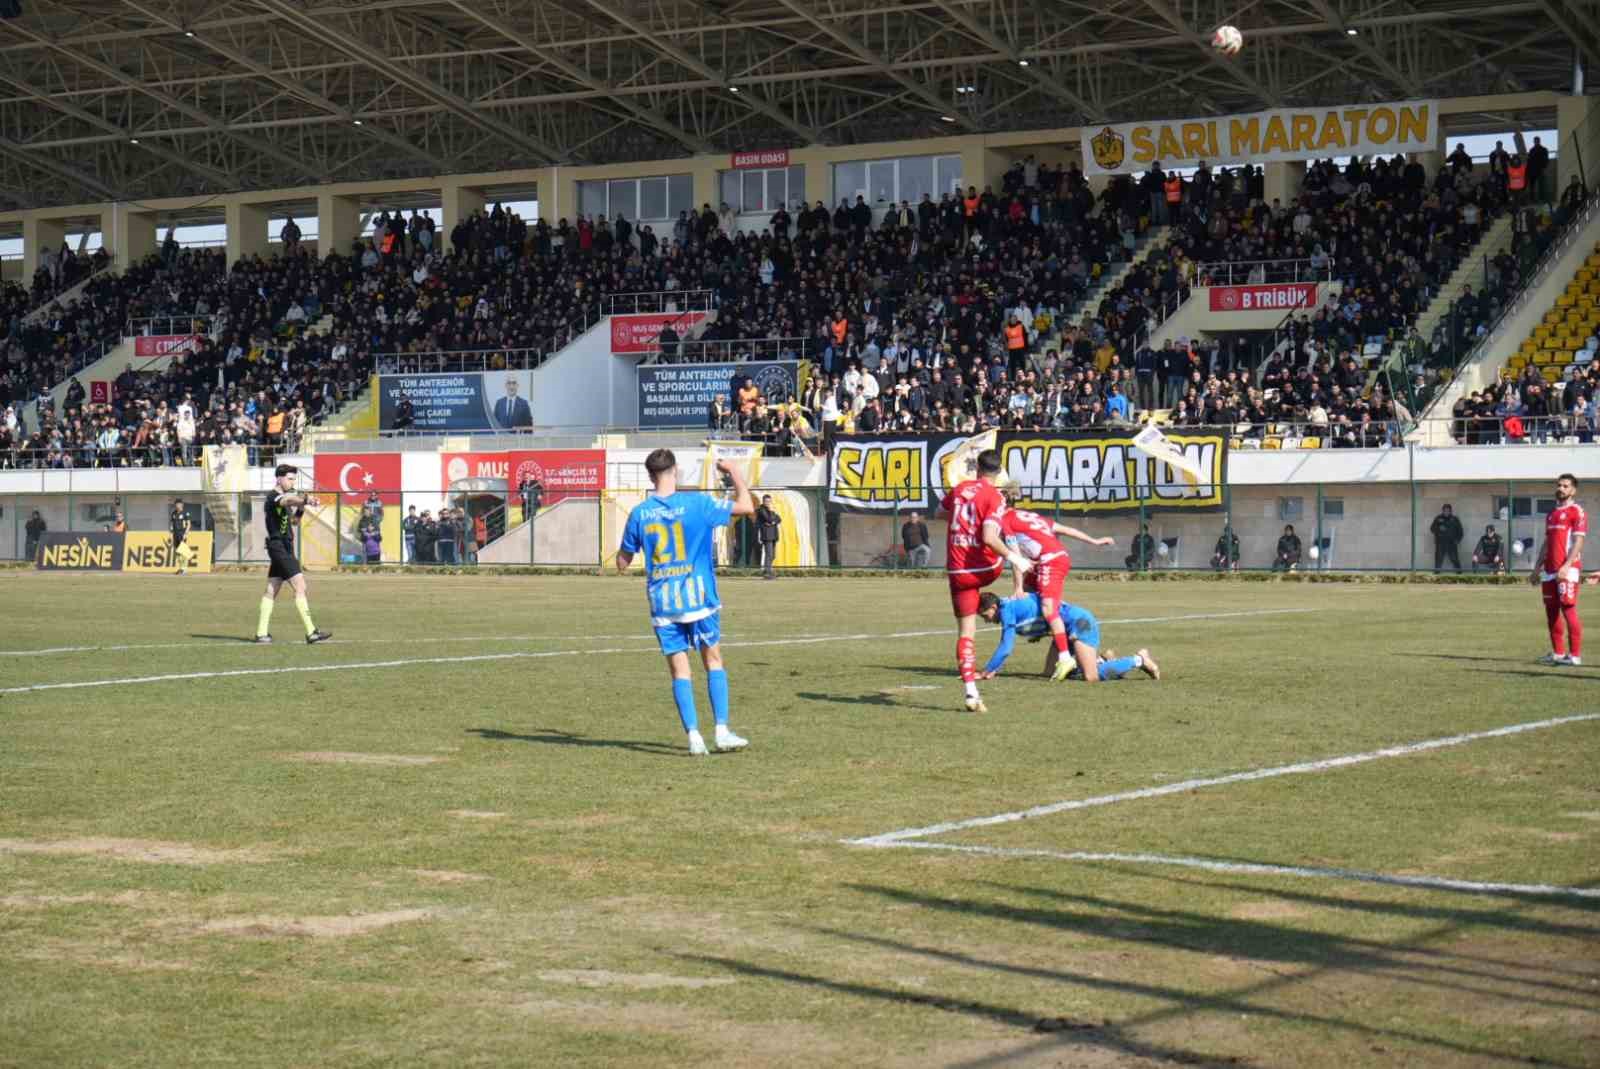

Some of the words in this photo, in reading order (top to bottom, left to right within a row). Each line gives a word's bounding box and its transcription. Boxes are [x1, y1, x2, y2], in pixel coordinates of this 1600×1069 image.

[1131, 121, 1219, 163] SARI
[1229, 103, 1429, 157] MARATON
[1242, 292, 1252, 308] B
[400, 378, 417, 388] TÜM
[654, 370, 677, 381] TÜM
[642, 383, 656, 392] VE
[836, 448, 921, 501] SARI
[644, 519, 688, 565] 21
